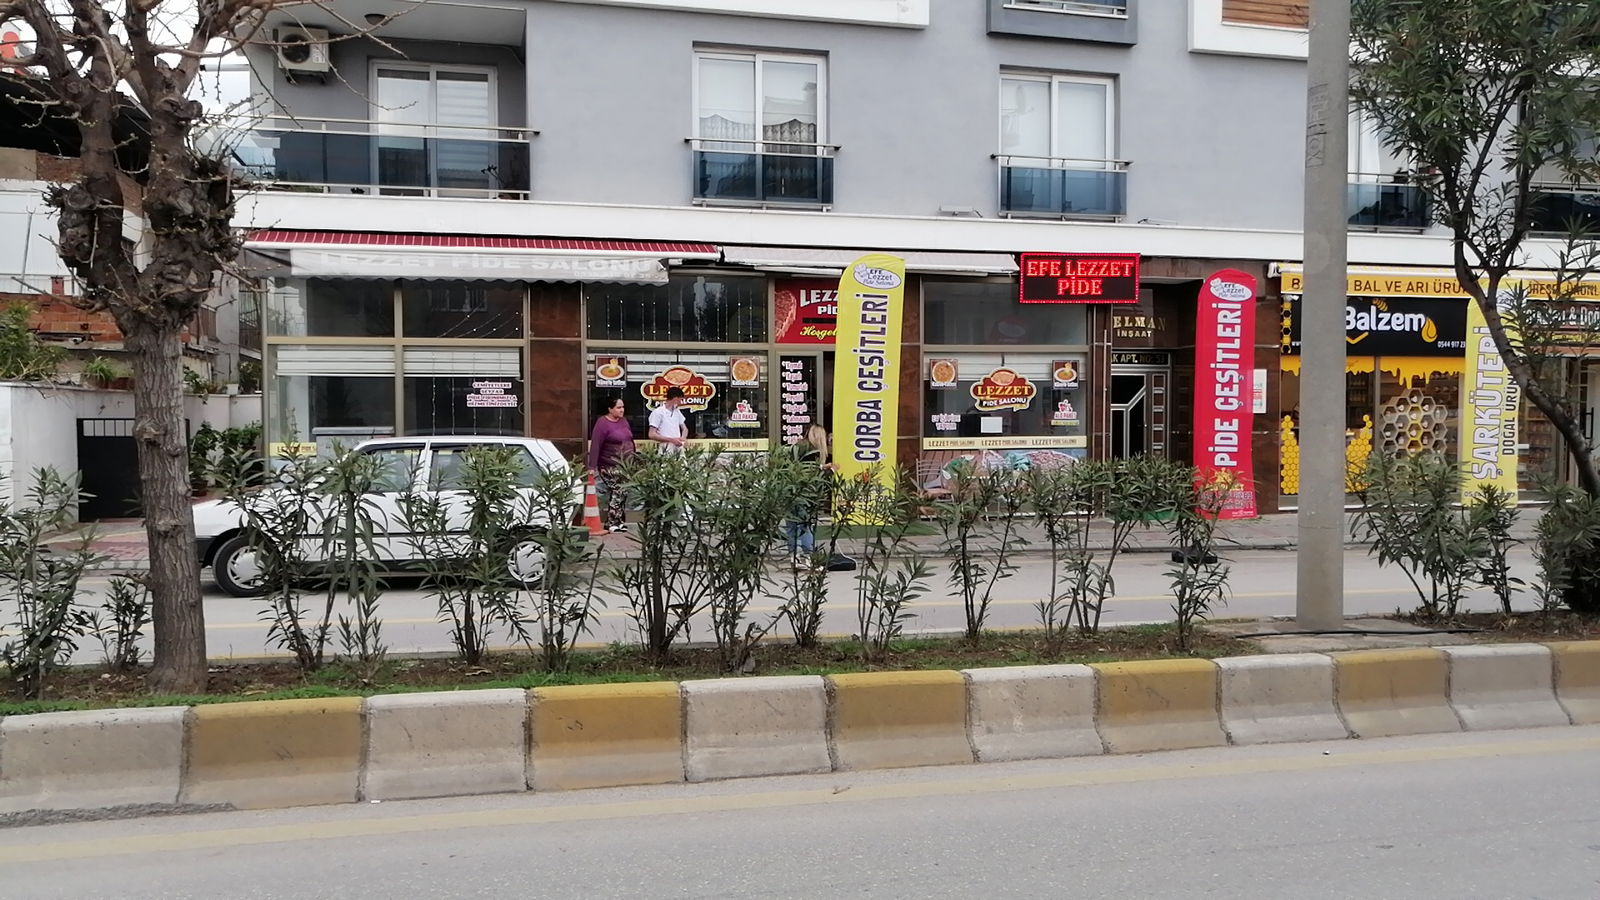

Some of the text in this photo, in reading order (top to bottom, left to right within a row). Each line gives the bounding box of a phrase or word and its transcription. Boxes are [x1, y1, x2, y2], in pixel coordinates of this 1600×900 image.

[531, 257, 653, 273] SALONU
[1026, 260, 1134, 277] EFE LEZZET
[1057, 277, 1103, 296] PİDE
[1354, 279, 1381, 292] BAL
[1386, 280, 1402, 292] VE
[1406, 281, 1429, 293] ARI
[853, 294, 889, 392] ÇEŞİTLERİ
[1120, 354, 1138, 364] APT.
[1210, 302, 1244, 411] ÇEŞİTLERİ
[650, 385, 711, 396] LEZET
[977, 385, 1031, 396] LEZZET
[999, 397, 1027, 406] SALONU
[854, 400, 886, 462] ÇORBA
[1501, 416, 1516, 455] DOĞAL
[1208, 418, 1239, 467] PİDE
